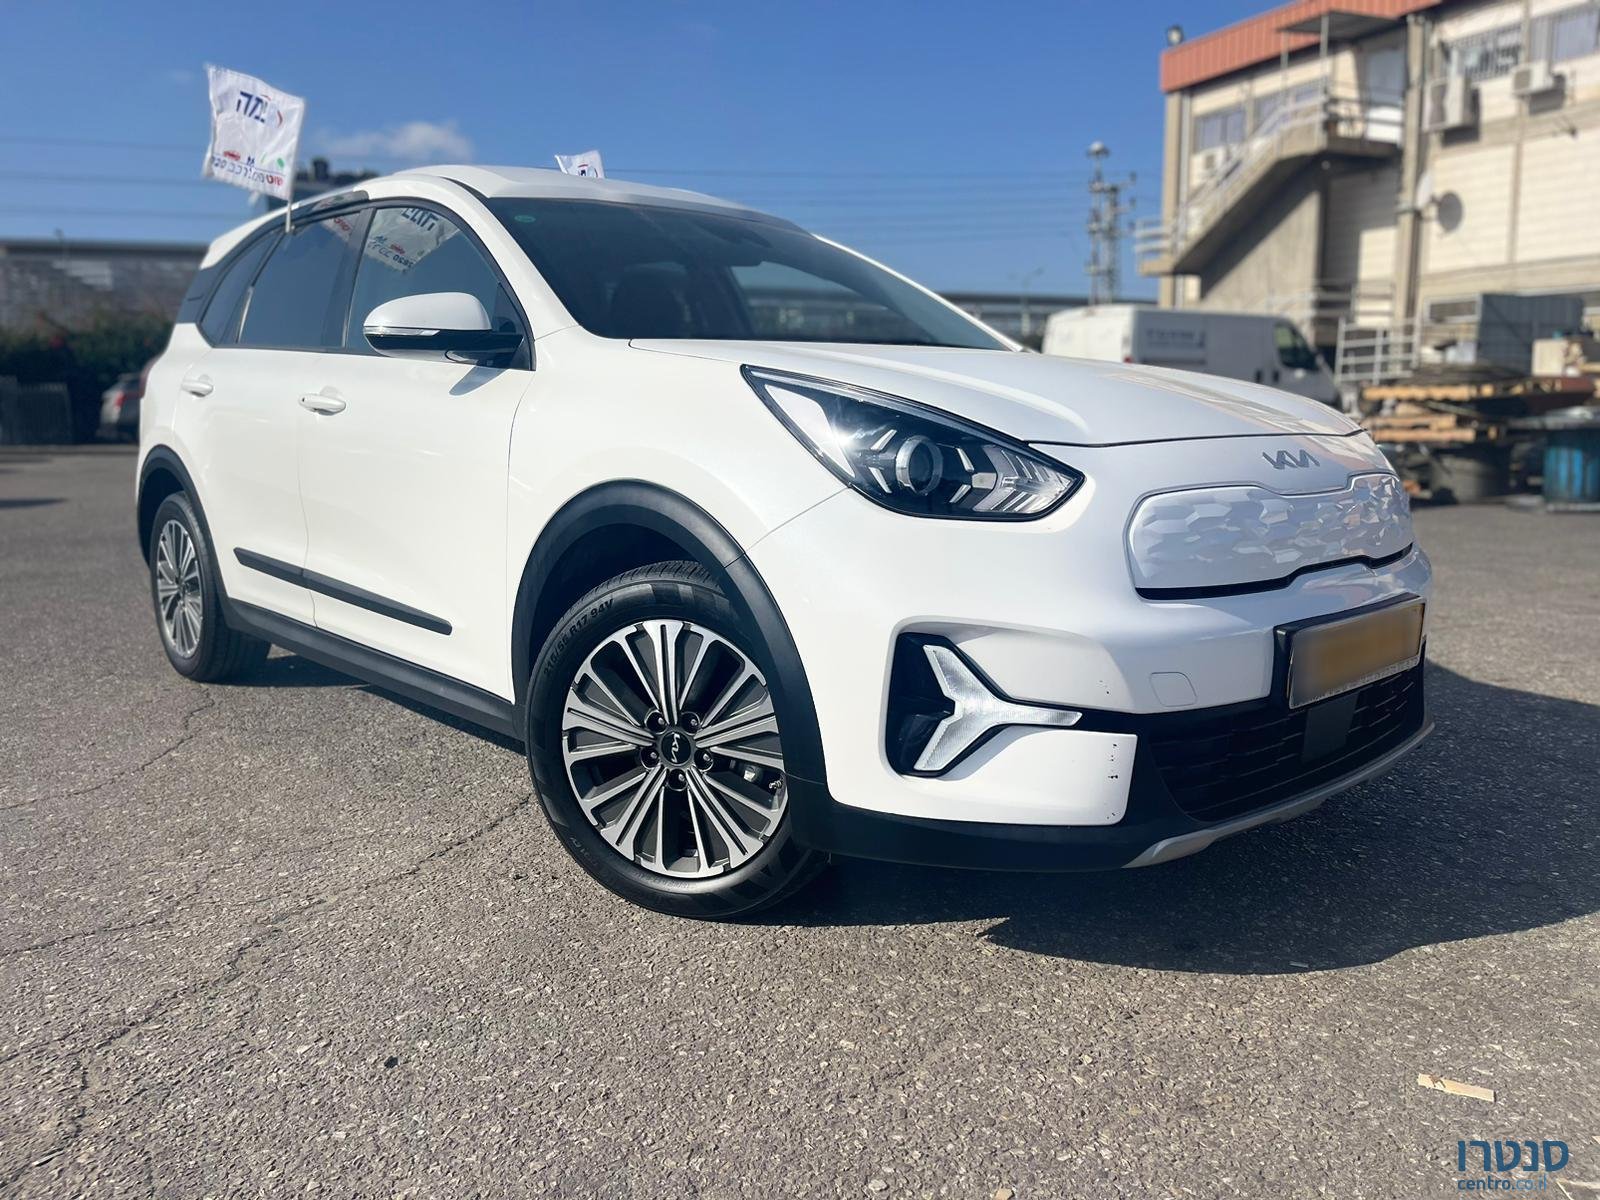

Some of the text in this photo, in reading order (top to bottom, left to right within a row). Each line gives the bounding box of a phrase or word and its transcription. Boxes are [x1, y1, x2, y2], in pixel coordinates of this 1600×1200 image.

[1262, 449, 1320, 470] KIA
[569, 614, 588, 635] R17
[590, 598, 614, 618] 94V
